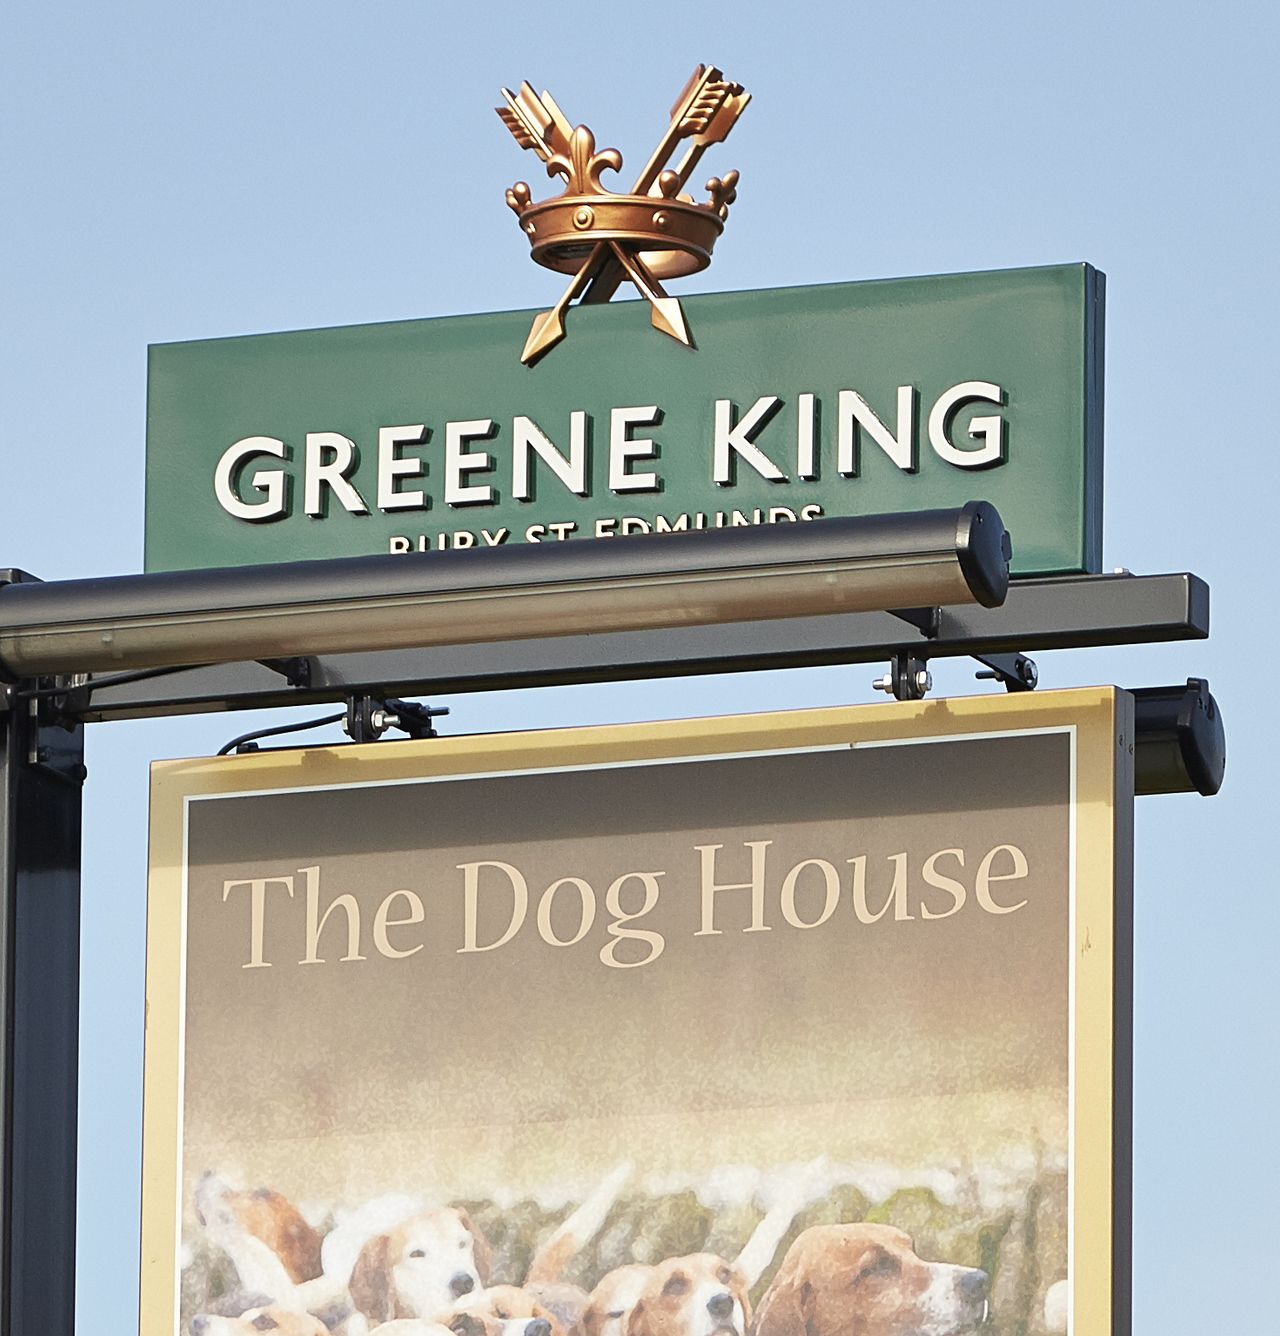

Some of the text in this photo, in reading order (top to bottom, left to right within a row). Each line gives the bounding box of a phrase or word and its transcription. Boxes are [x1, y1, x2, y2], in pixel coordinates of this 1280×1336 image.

[214, 380, 1006, 522] GREENE KING
[222, 840, 1029, 969] The Dog House
